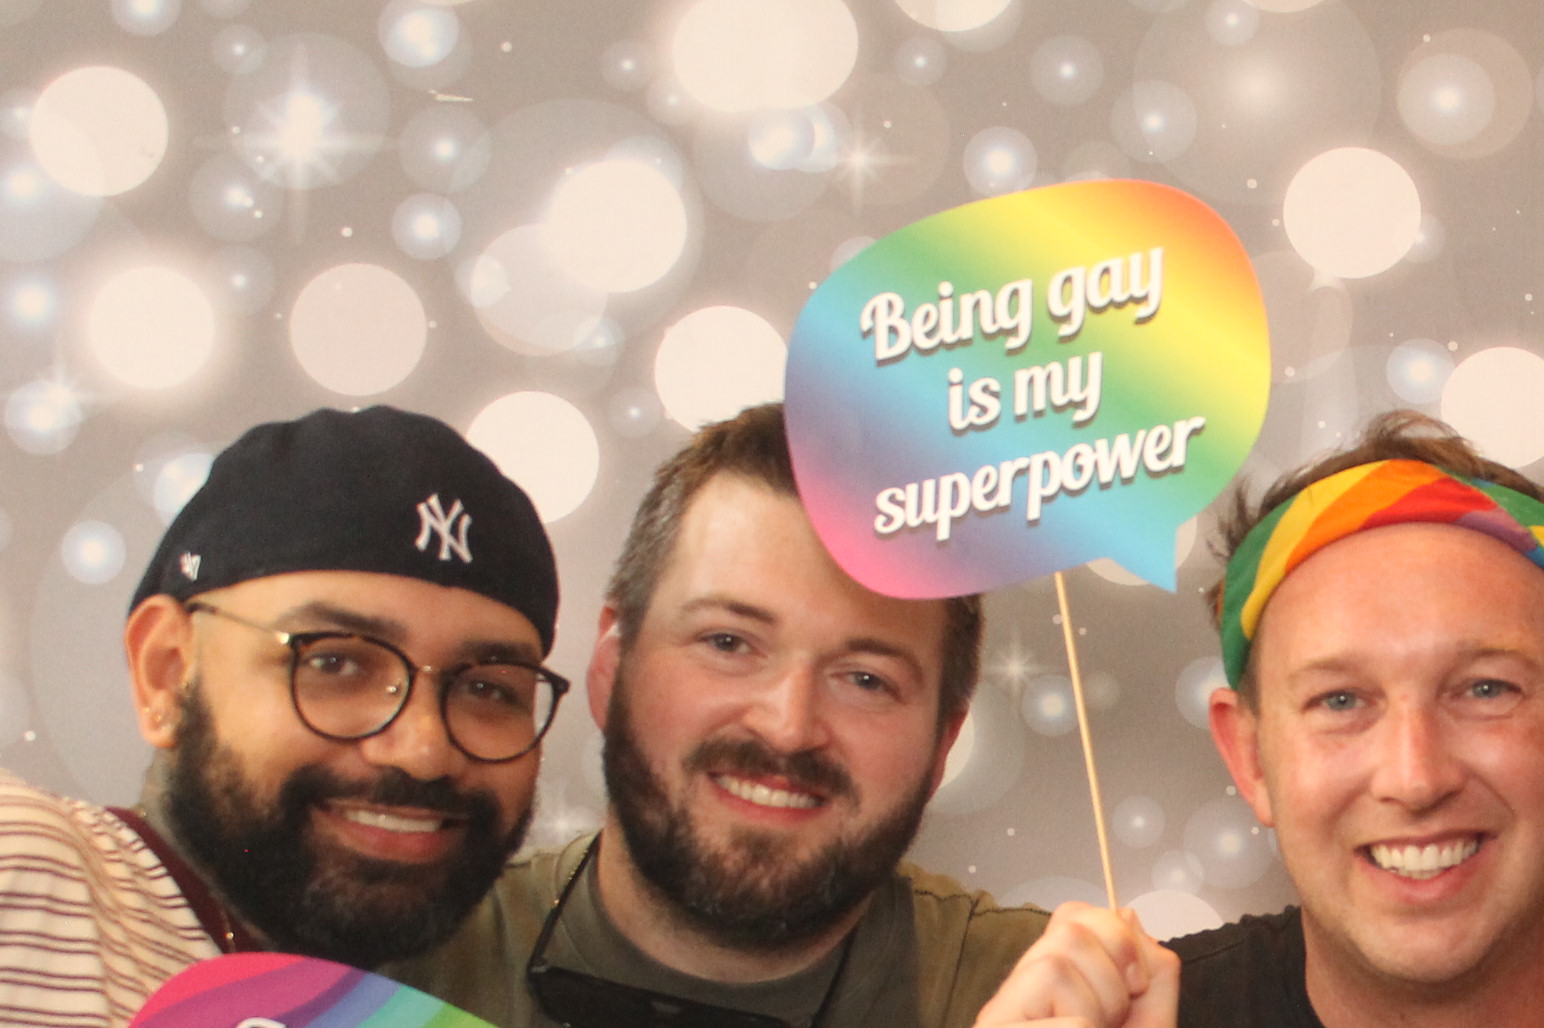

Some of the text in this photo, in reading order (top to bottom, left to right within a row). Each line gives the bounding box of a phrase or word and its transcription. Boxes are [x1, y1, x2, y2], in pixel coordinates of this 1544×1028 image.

[860, 246, 1164, 363] Being gay
[947, 351, 1103, 432] is my
[873, 415, 1206, 541] superpower
[415, 493, 473, 564] NY
